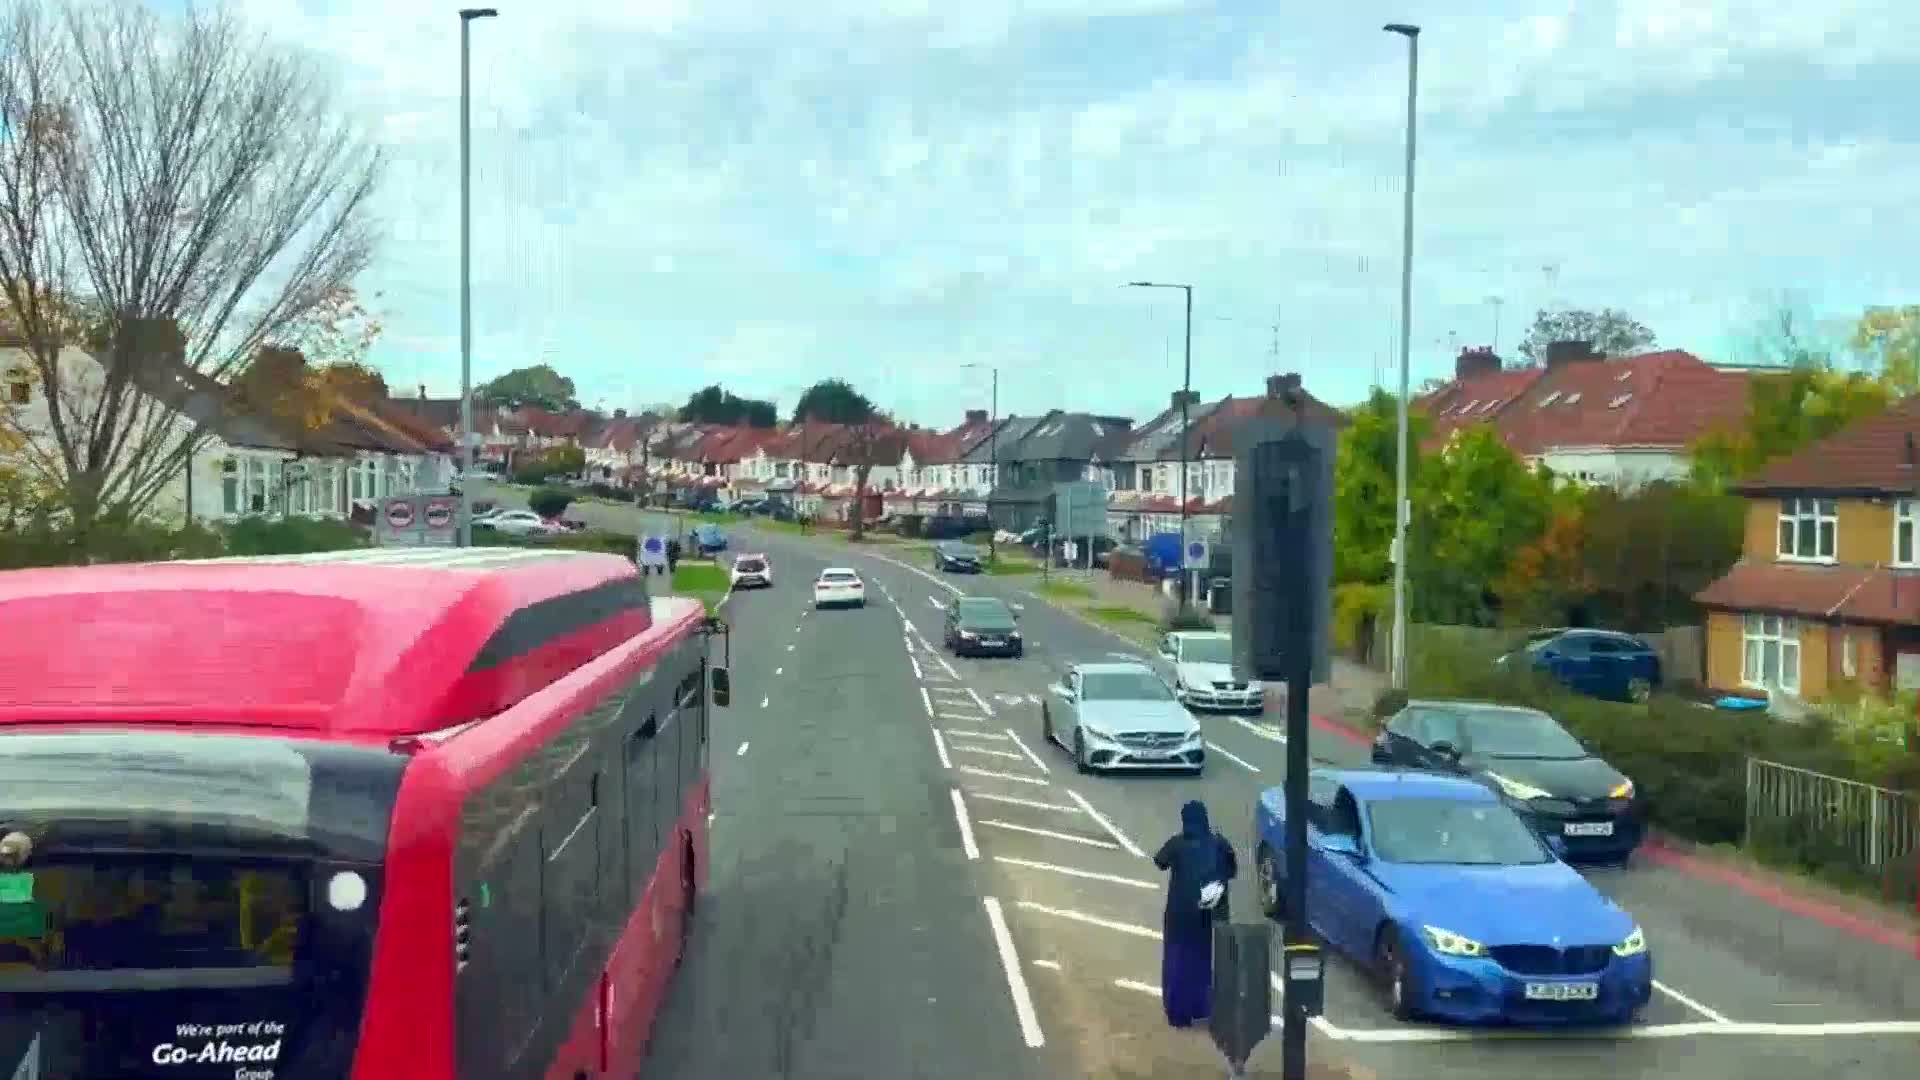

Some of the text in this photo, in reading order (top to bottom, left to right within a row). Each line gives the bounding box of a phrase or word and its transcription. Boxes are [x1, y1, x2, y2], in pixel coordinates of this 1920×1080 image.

[176, 1019, 285, 1038] We're part of the
[152, 1039, 282, 1064] Go-Ahead
[234, 1066, 274, 1080] Group
